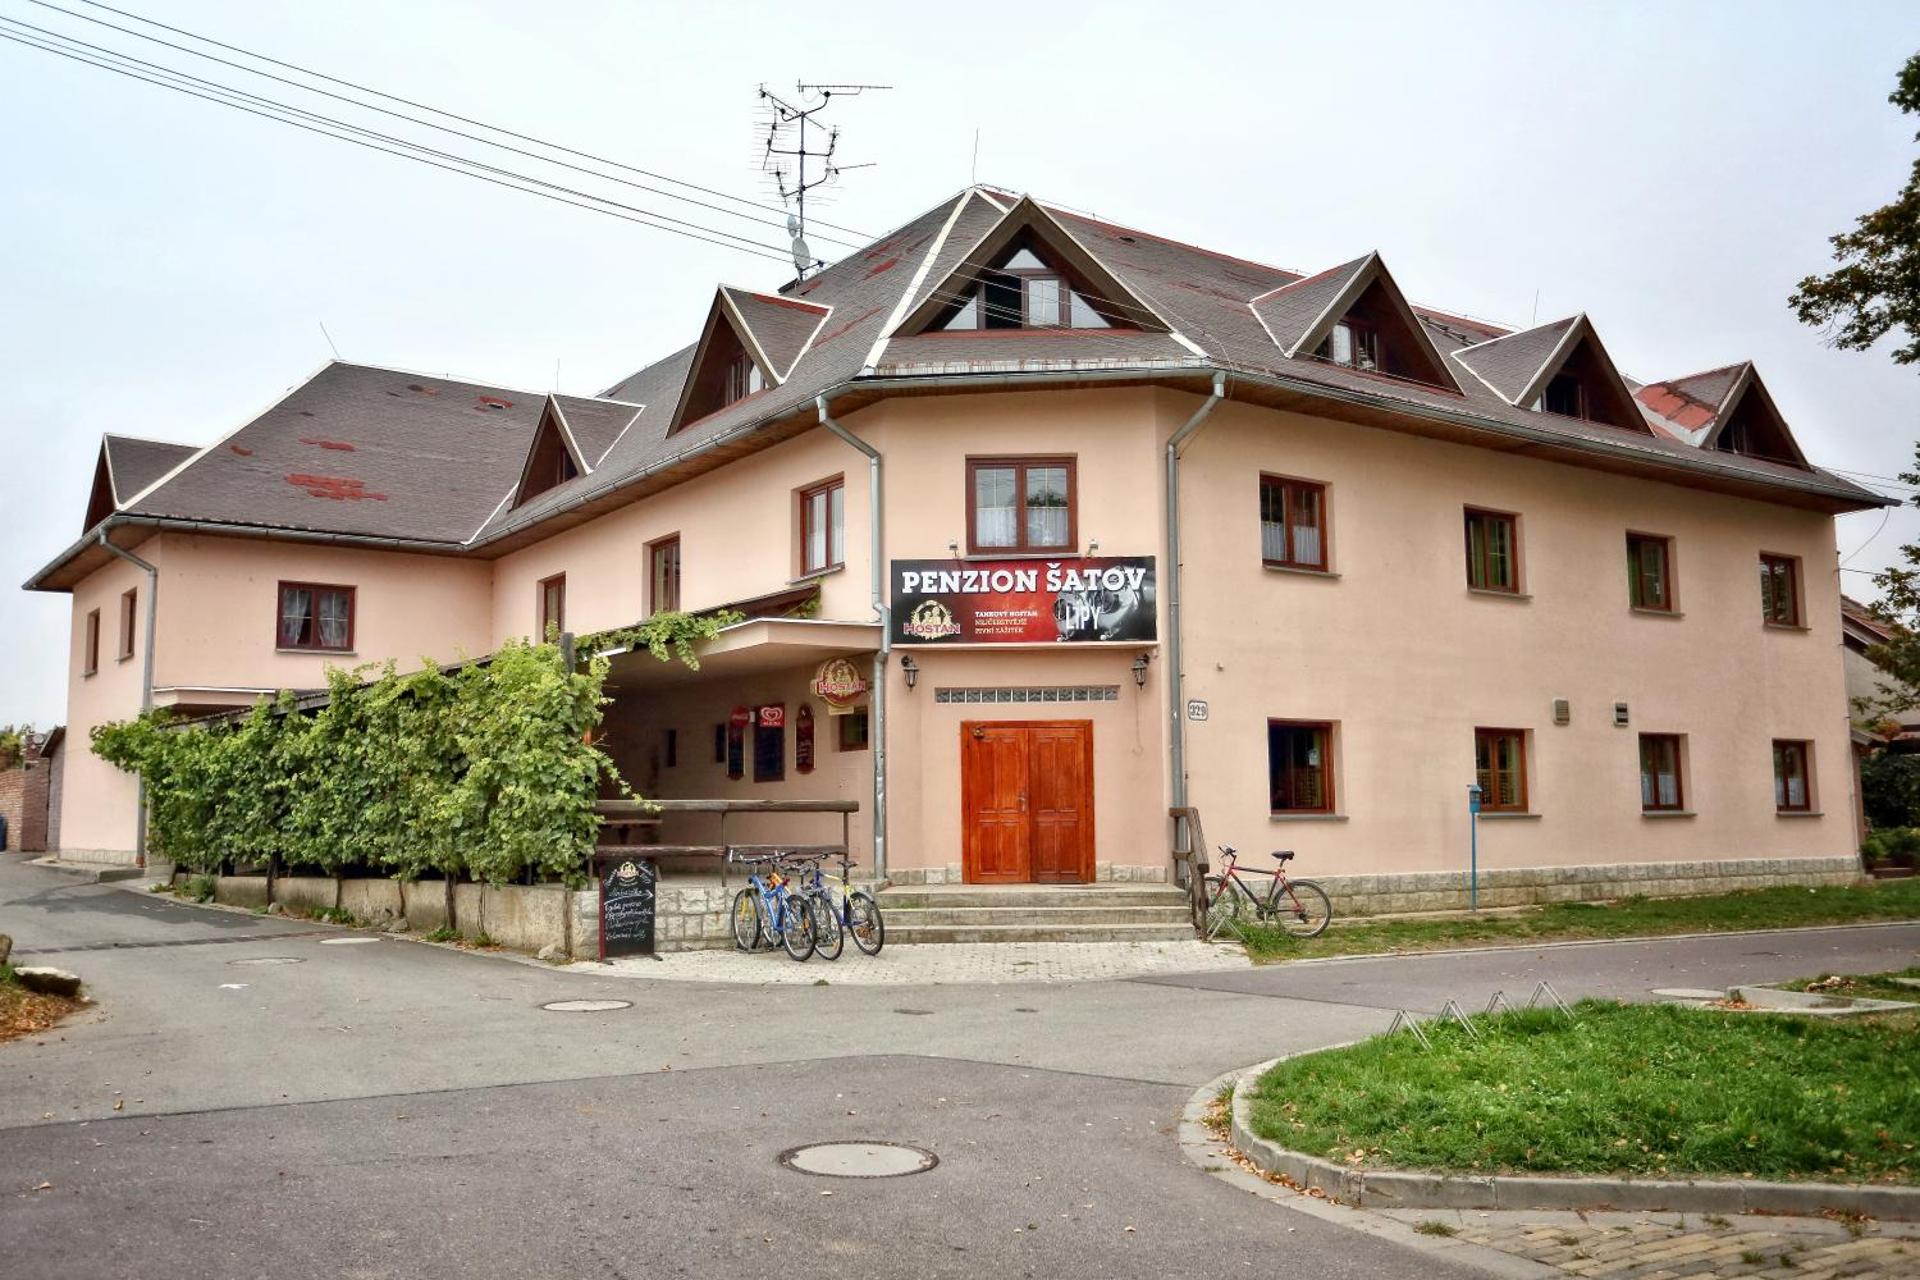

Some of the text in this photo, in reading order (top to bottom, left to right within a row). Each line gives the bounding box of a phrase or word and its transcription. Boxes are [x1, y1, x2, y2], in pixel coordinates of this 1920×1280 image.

[902, 563, 1146, 594] PENZION ŠATOV
[903, 622, 961, 635] HOSTAN
